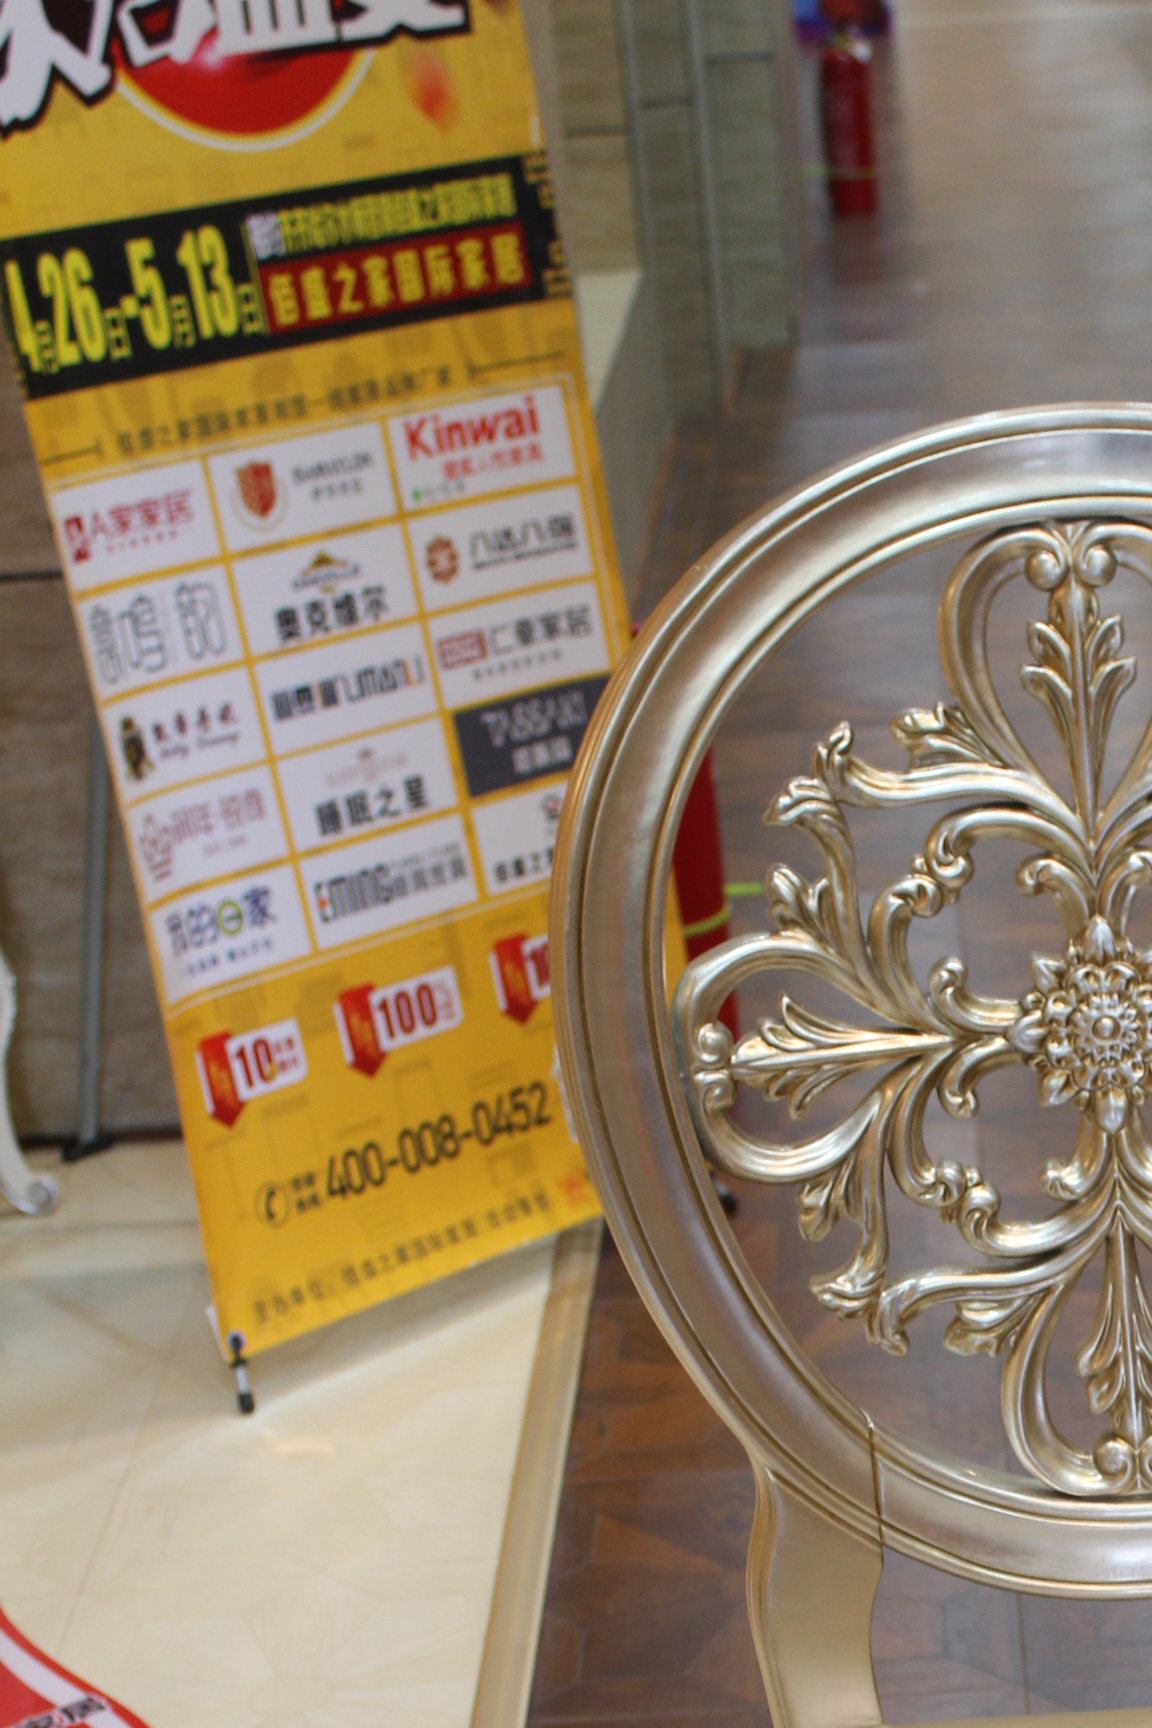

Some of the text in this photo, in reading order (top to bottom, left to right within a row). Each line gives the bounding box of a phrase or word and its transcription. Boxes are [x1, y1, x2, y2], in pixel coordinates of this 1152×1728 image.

[403, 394, 542, 461] Kinwai
[376, 982, 439, 1041] 100
[234, 1036, 278, 1089] 10
[322, 1080, 552, 1202] 400-008-0452
